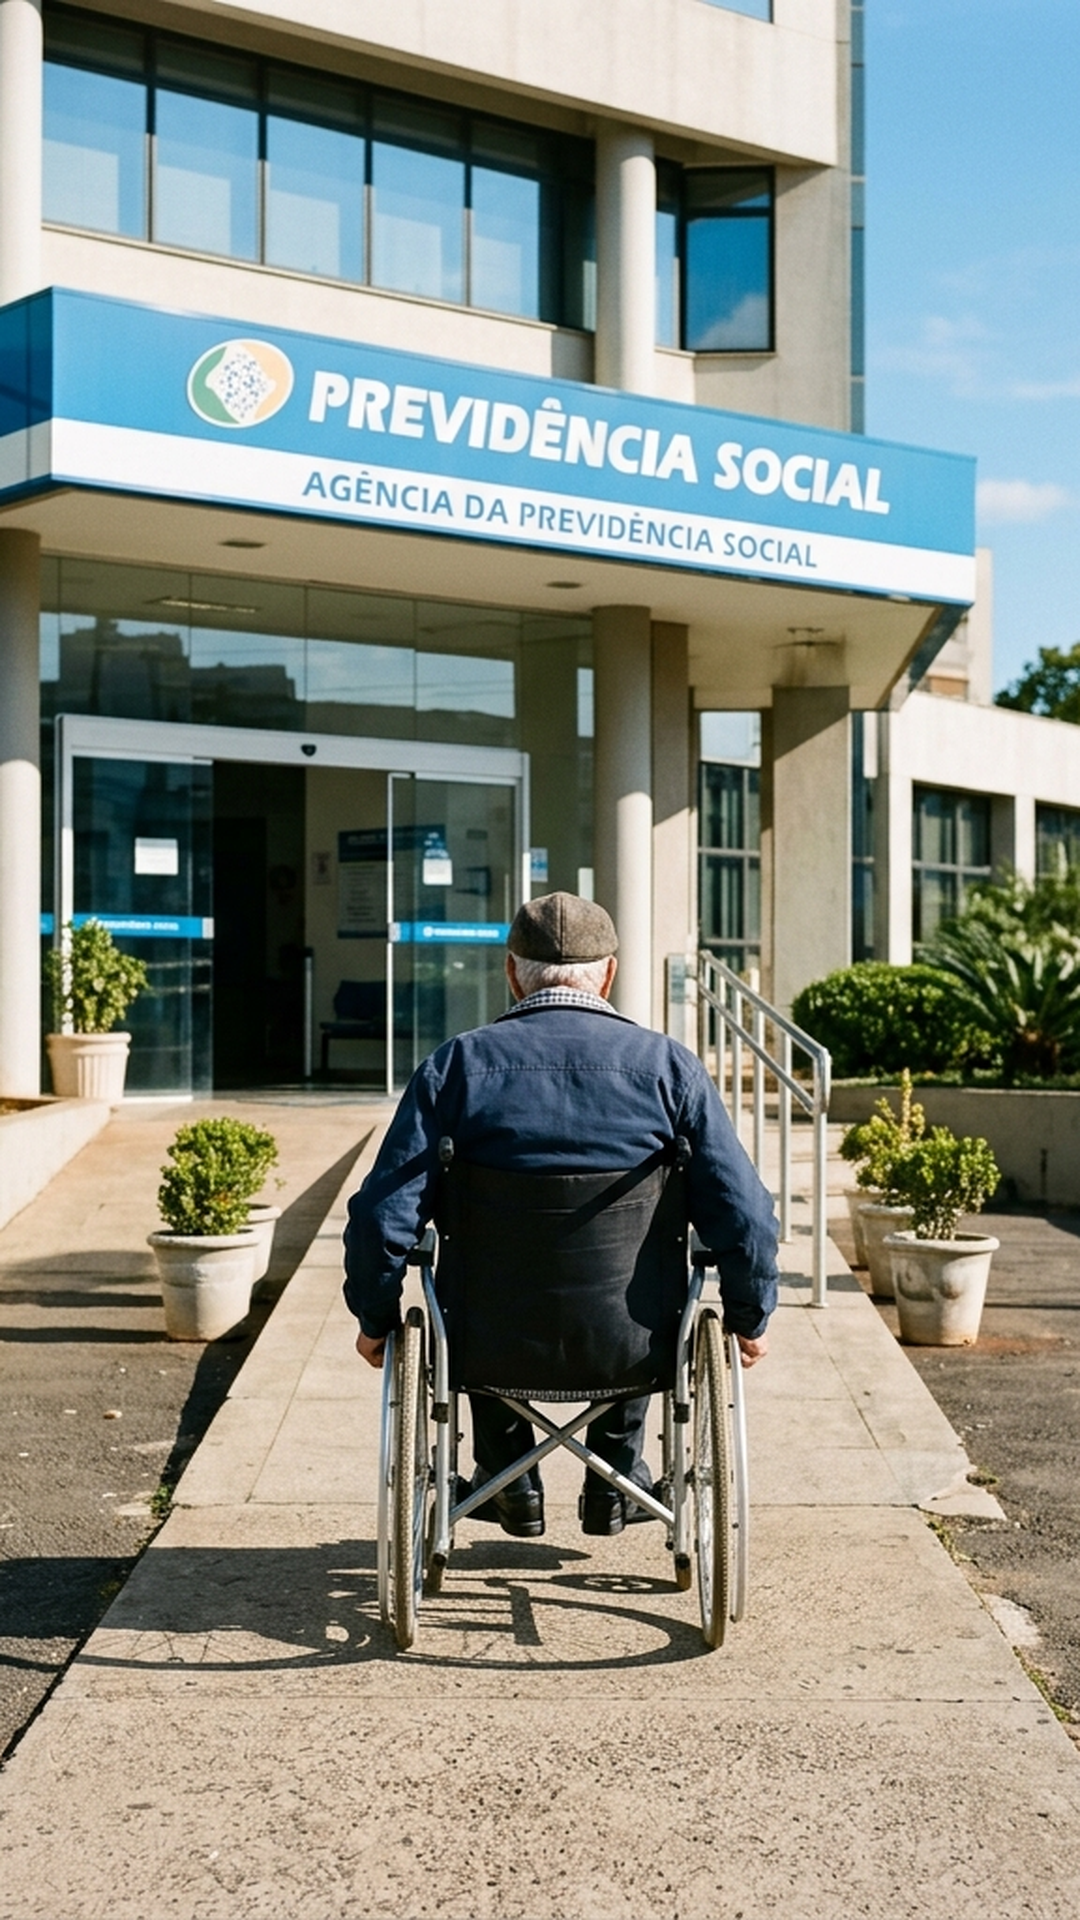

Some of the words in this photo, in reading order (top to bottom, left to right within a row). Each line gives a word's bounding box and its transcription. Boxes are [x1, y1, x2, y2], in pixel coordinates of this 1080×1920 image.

[309, 371, 698, 483] PREVIDÊNCIA
[714, 442, 890, 514] SOCIAL
[302, 470, 453, 517] AGÊNCIA
[464, 494, 509, 524] DA
[723, 532, 817, 569] SOCIAL
